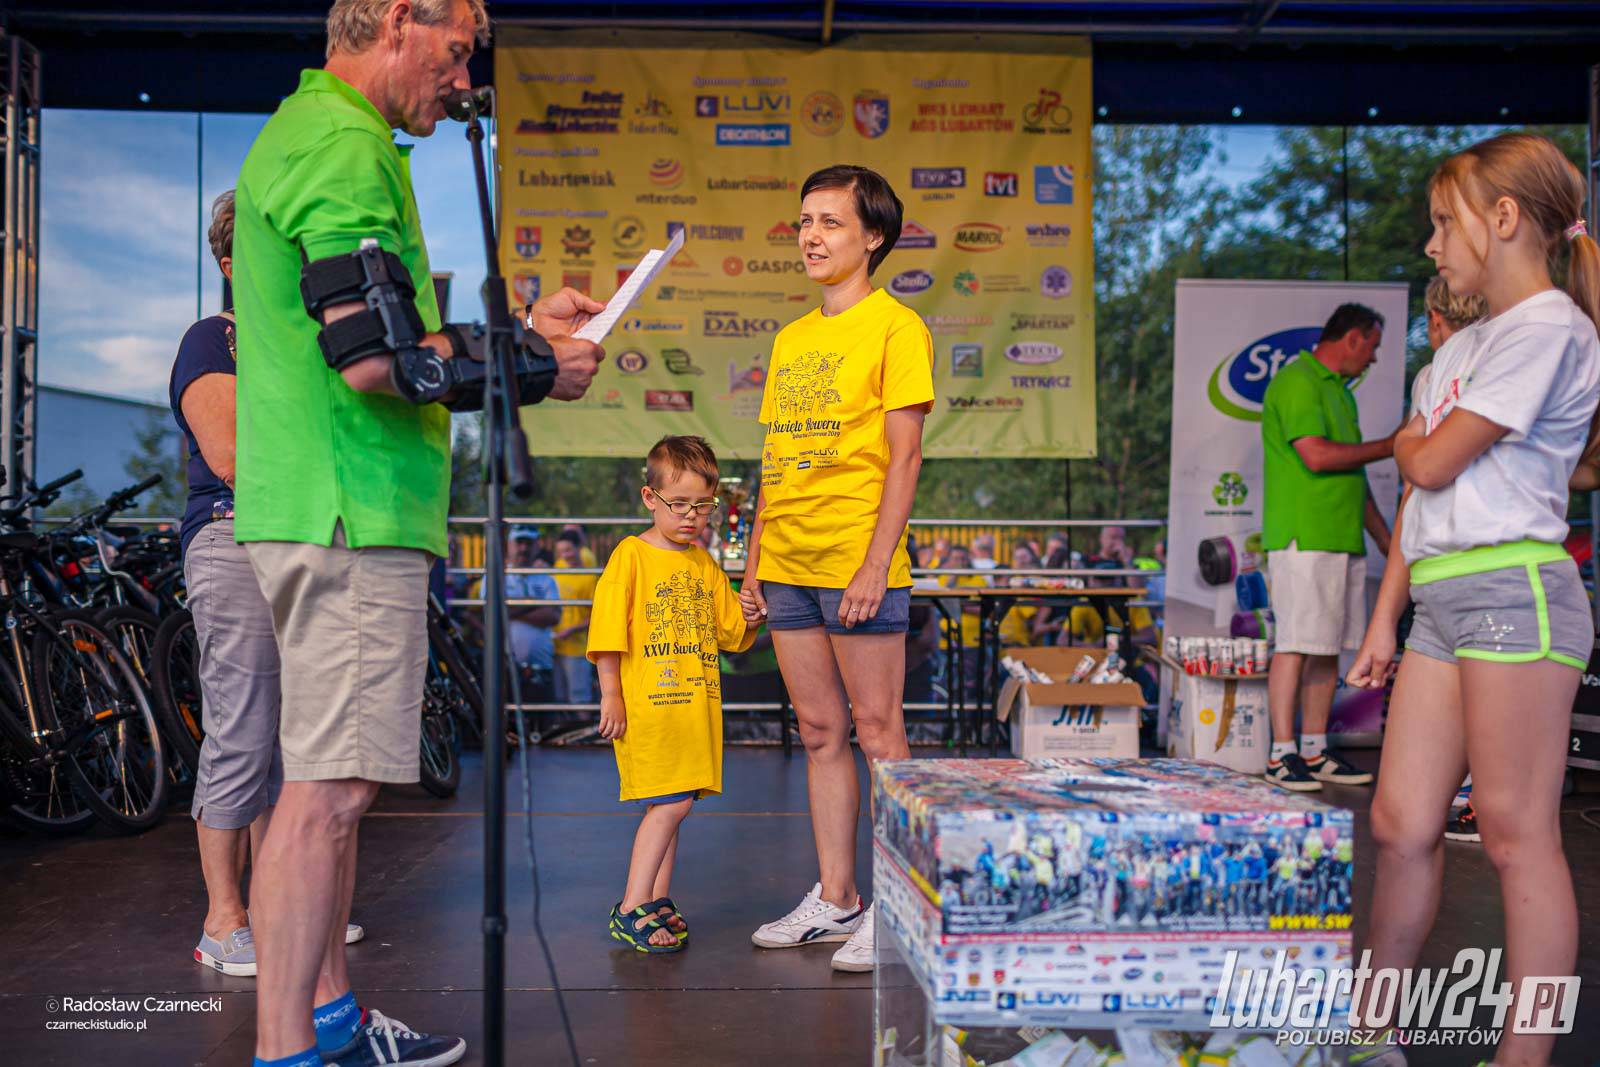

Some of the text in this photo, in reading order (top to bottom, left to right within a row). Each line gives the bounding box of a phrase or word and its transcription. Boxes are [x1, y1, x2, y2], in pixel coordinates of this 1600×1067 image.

[723, 94, 791, 111] LUVI
[719, 129, 787, 141] DECATHLON
[747, 260, 806, 273] GASPO
[704, 317, 780, 333] DAKO
[806, 418, 841, 432] Roweru
[813, 448, 839, 456] LUVI
[643, 642, 670, 658] XXVI
[1572, 737, 1581, 752] 2
